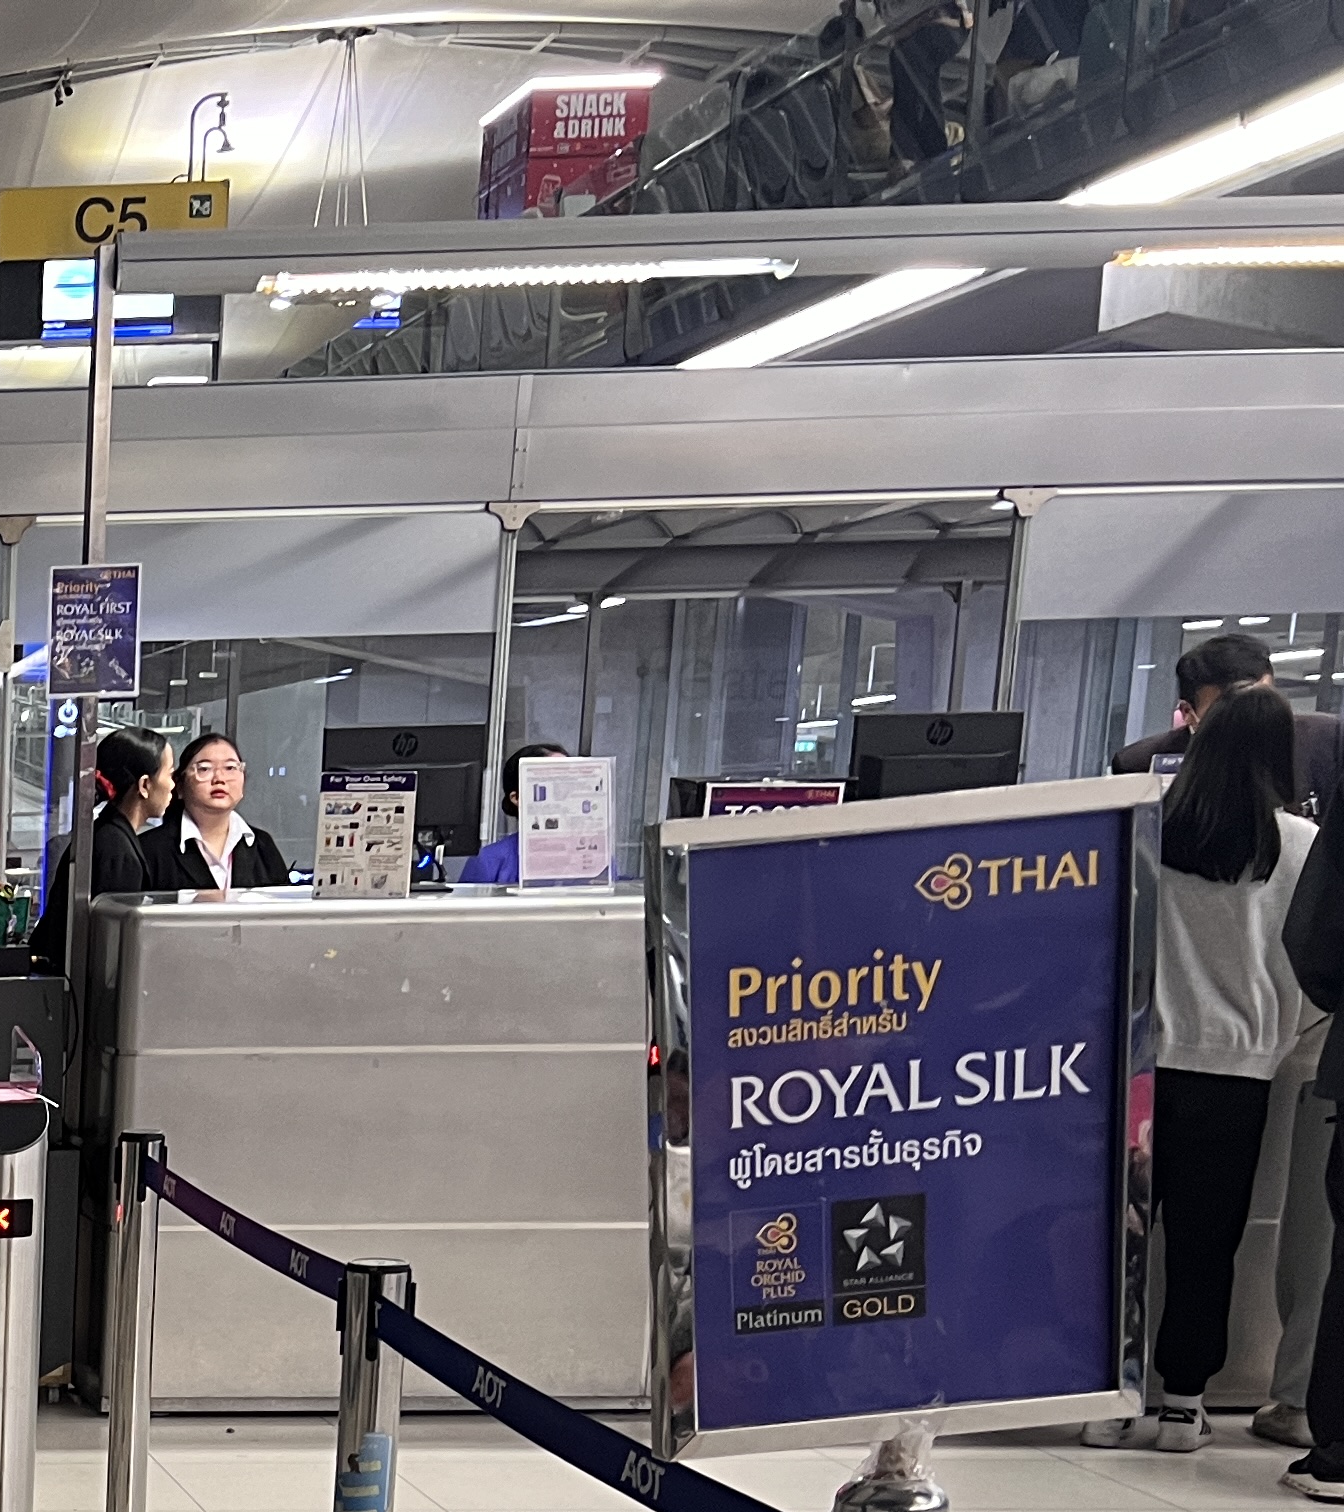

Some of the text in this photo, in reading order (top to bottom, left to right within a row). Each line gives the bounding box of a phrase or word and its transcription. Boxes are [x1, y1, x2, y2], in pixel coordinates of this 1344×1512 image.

[555, 91, 628, 119] SNACK
[75, 196, 147, 243] C5
[57, 580, 99, 595] Priority
[56, 601, 133, 616] ROYAL FIRST
[56, 629, 95, 642] ROYAL
[978, 849, 1100, 897] THAI
[728, 948, 943, 1019] Priority
[728, 1007, 908, 1048] สงวนสิทธิ์สำหรับ
[730, 1042, 1092, 1130] ROYAL SILK
[728, 1129, 984, 1190] ผู้โดยสารชั้นธุรกิจ
[750, 1270, 806, 1287] ORCHID
[756, 1257, 802, 1273] ROYAL
[762, 1285, 797, 1300] PLUS
[843, 1272, 915, 1287] STAR ALLIANCE
[736, 1308, 823, 1331] Platinum
[843, 1294, 916, 1320] GOLD
[472, 1365, 507, 1408] AOT
[620, 1450, 666, 1501] AOT
